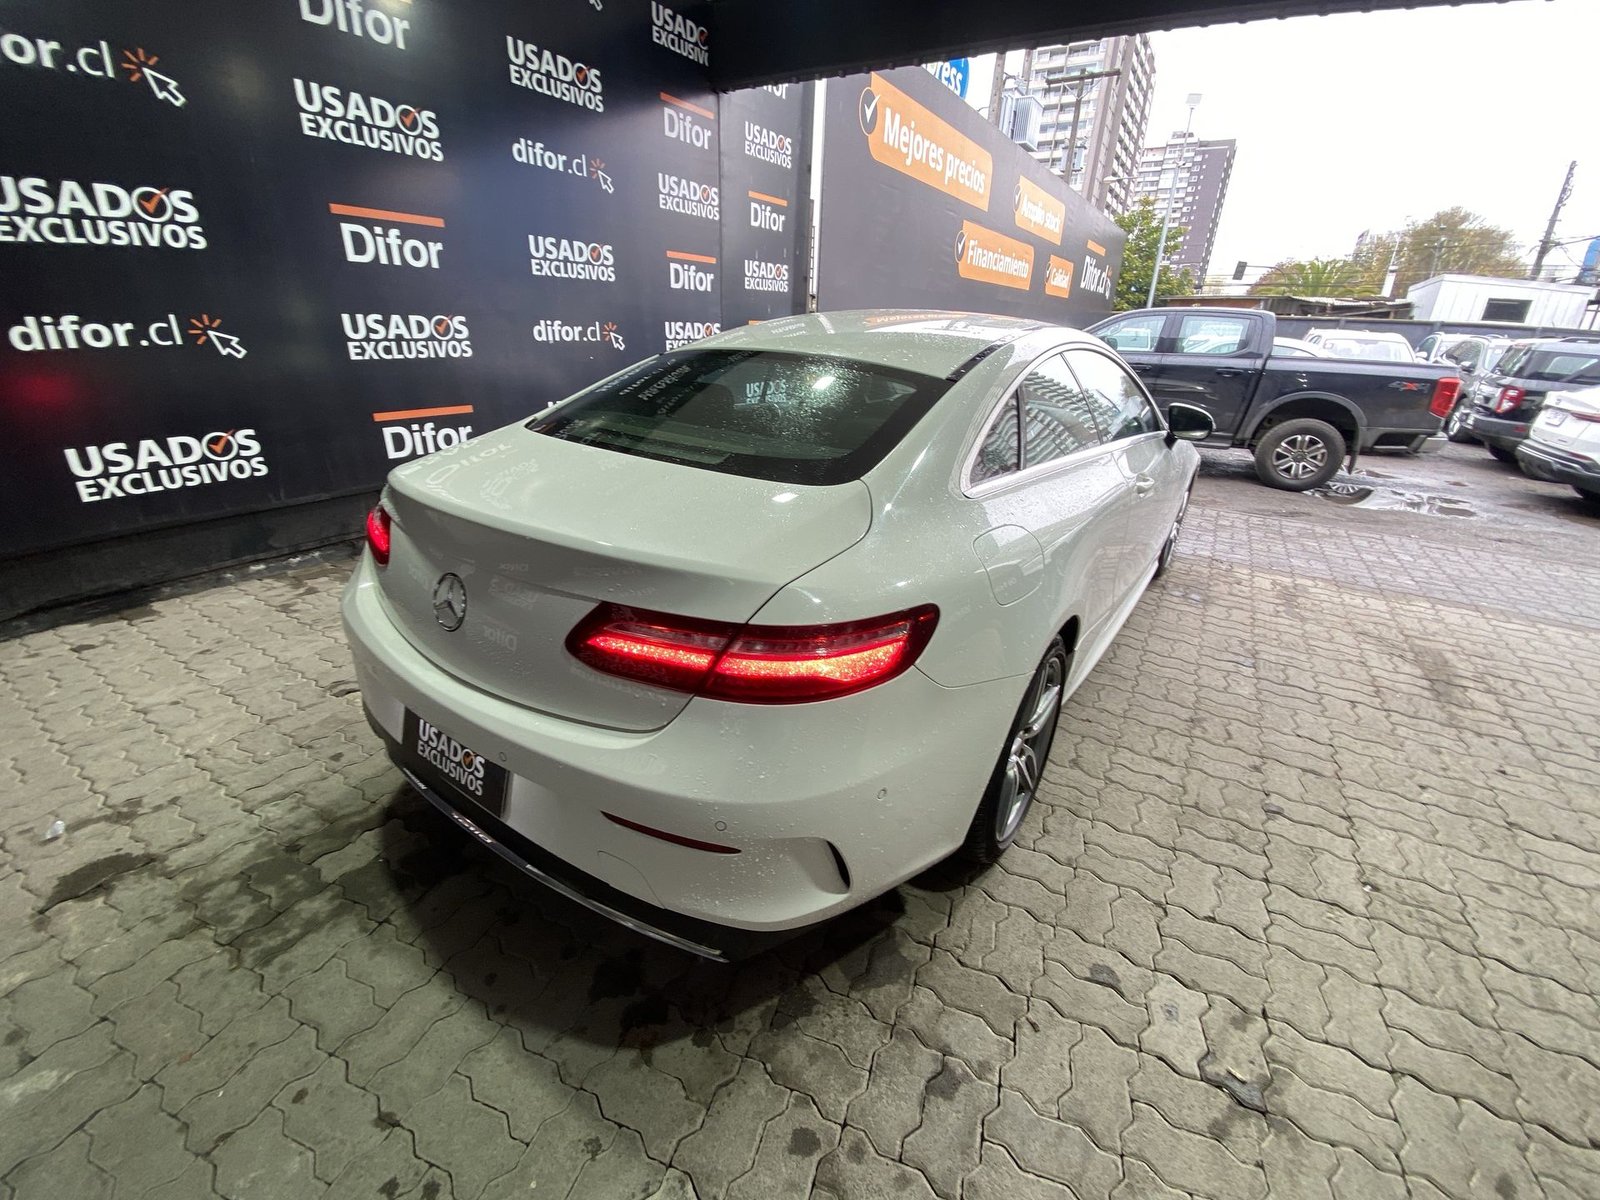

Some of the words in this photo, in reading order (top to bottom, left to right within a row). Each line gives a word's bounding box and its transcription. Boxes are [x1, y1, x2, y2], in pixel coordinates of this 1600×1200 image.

[651, 0, 709, 50] USADO
[506, 35, 603, 93] USADOS
[652, 24, 710, 67] EXCLUSIV
[509, 63, 605, 113] EXCLUSIVOS
[293, 78, 440, 139] USADOS
[299, 112, 444, 162] EXCLUSIVOS
[663, 106, 712, 150] Difor
[744, 121, 792, 155] USADOS
[512, 138, 588, 177] difor.cl
[744, 140, 792, 169] EXCLUSIVOS
[883, 107, 944, 171] Mejores
[945, 152, 986, 194] precios
[658, 173, 719, 206] USADOS
[659, 194, 720, 221] EXCLUSIVOS
[0, 216, 208, 249] EXCLUSIVOS
[750, 201, 786, 232] Difor
[339, 222, 443, 269] Difor
[528, 234, 614, 266] USADOS
[967, 239, 1029, 279] Financiamiento
[530, 259, 616, 282] EXCLUSIVOS
[669, 262, 714, 292] Difor
[744, 259, 788, 281] USADOS
[744, 277, 788, 292] EXCLUSIVOS
[8, 313, 183, 352] difor.cl
[341, 313, 469, 340] USADOS
[533, 320, 600, 343] difor.cl
[664, 321, 721, 340] USADOS
[347, 340, 473, 360] EXCLUSIVOS
[64, 429, 262, 478] USADOS
[382, 422, 473, 460] Difor
[75, 457, 269, 503] EXCLUSIVOS
[417, 740, 483, 796] EXCLUSIVOS
[418, 719, 486, 779] USADOS
